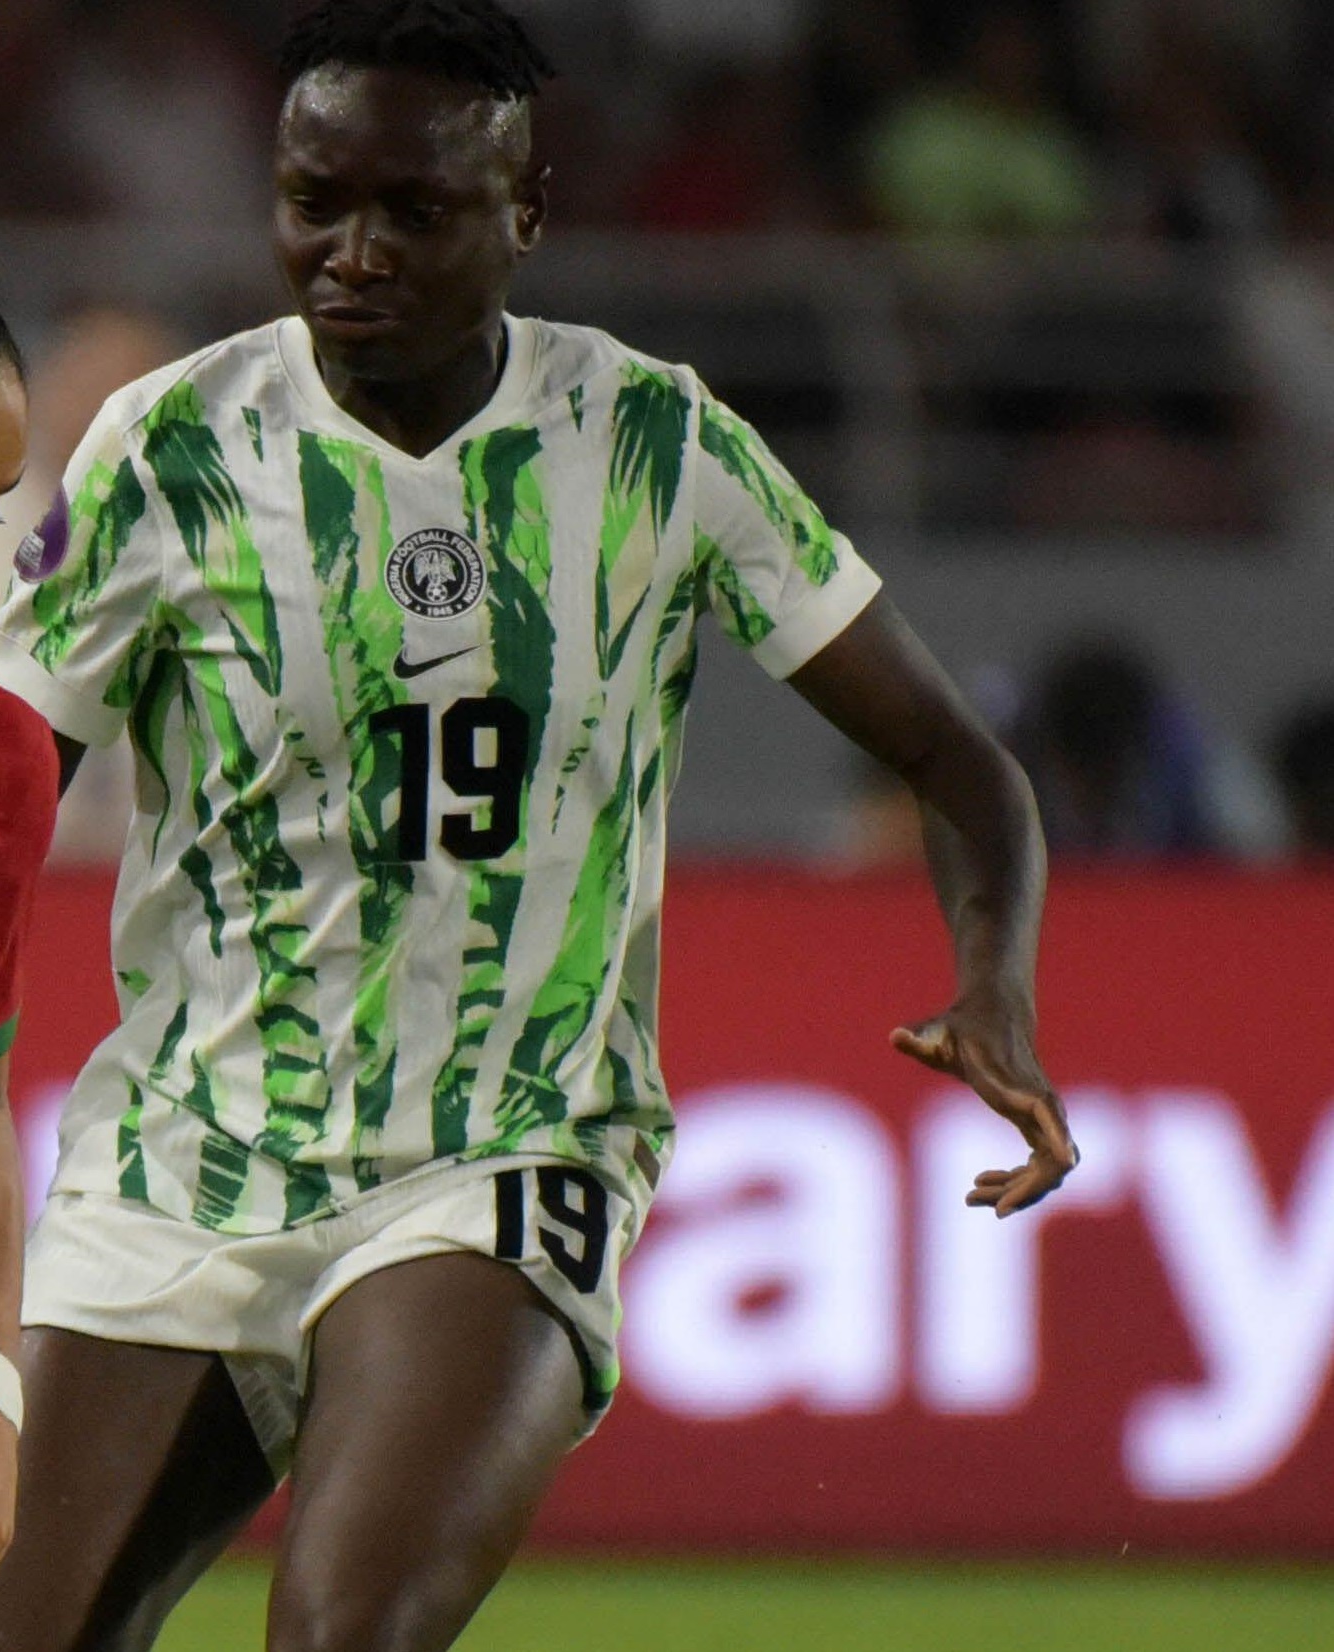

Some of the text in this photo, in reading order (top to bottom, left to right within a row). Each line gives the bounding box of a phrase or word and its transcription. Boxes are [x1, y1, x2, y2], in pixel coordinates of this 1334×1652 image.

[389, 531, 481, 606] NIGERIA FOOTBALL FEDERATION
[427, 605, 453, 616] 1945
[369, 697, 529, 860] 19
[494, 1165, 608, 1294] 19
